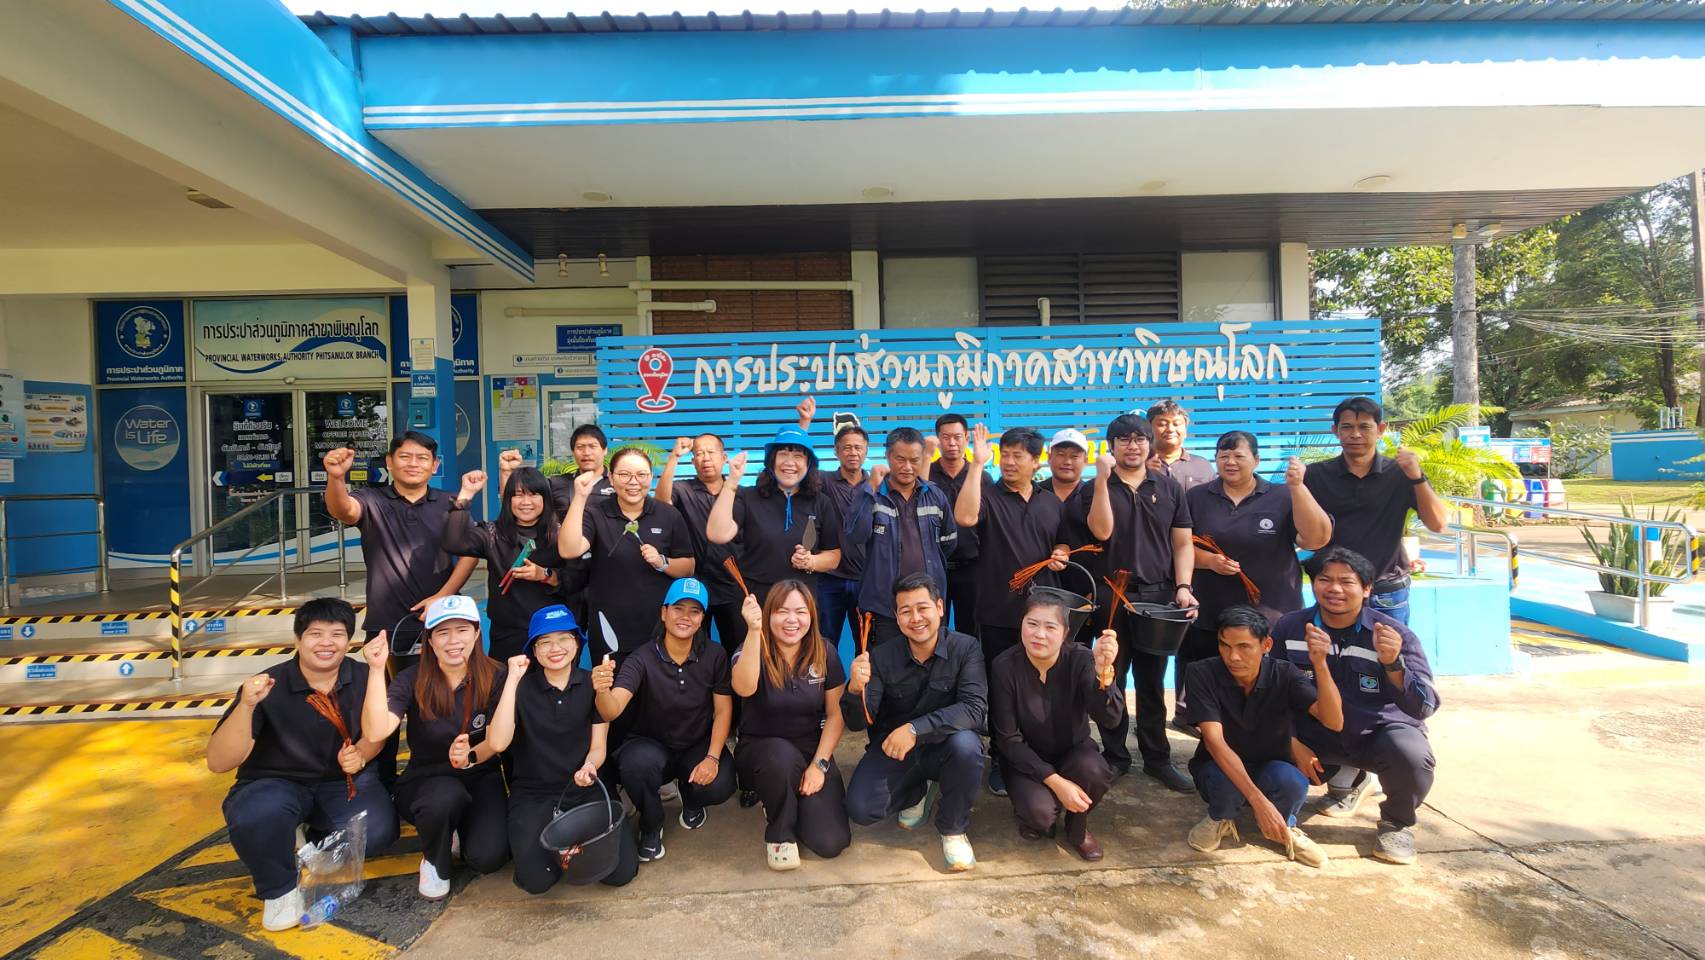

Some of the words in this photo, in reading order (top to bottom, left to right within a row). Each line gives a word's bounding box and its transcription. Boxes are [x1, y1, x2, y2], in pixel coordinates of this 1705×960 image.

[203, 316, 379, 343] การประปาส่วนภูมิภาคสาขาพิษณุโลก
[205, 353, 239, 362] PROVINCIAL
[240, 352, 281, 362] WATERWORKS
[283, 351, 314, 361] AUTHORITY
[315, 350, 354, 360] PHITSANULOK
[355, 350, 380, 360] BRANCH
[694, 322, 1288, 409] การประปาส่วนภูมิภาคสาขาพิษณุโลก
[125, 419, 172, 429] Water
[324, 419, 369, 428] WELCOME
[138, 429, 168, 444] Life
